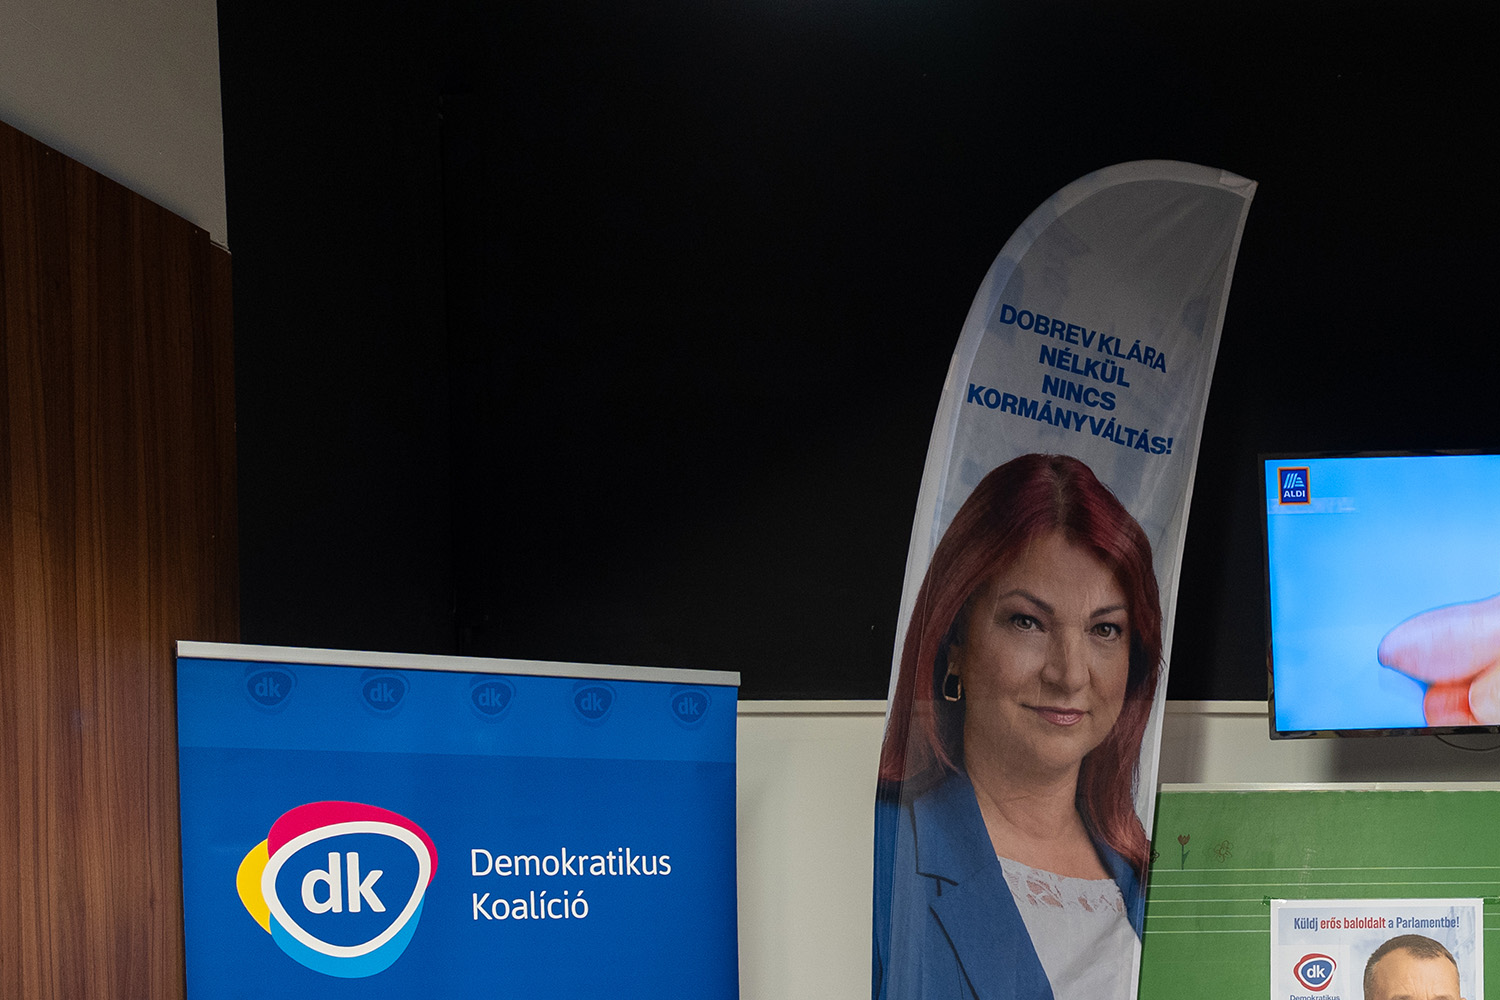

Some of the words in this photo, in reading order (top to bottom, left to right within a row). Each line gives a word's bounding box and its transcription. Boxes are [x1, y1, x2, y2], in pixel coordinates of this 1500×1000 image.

[1000, 304, 1097, 348] DOBREV
[1098, 333, 1167, 373] KLÁRA
[1039, 345, 1130, 388] NÉLKÜL
[1041, 374, 1116, 411] NINCS
[967, 383, 1173, 455] KORMÁNYVÁLTÁS!
[1283, 490, 1306, 498] ALDI
[471, 848, 671, 877] Demokratikus
[301, 851, 386, 914] dk
[472, 890, 589, 921] Koalíció
[1294, 918, 1318, 931] Küldj
[1320, 917, 1341, 929] erős
[1344, 917, 1386, 929] baloldalt
[1388, 920, 1394, 928] a
[1396, 916, 1460, 928] Parlamentbe!
[1307, 964, 1326, 978] dk
